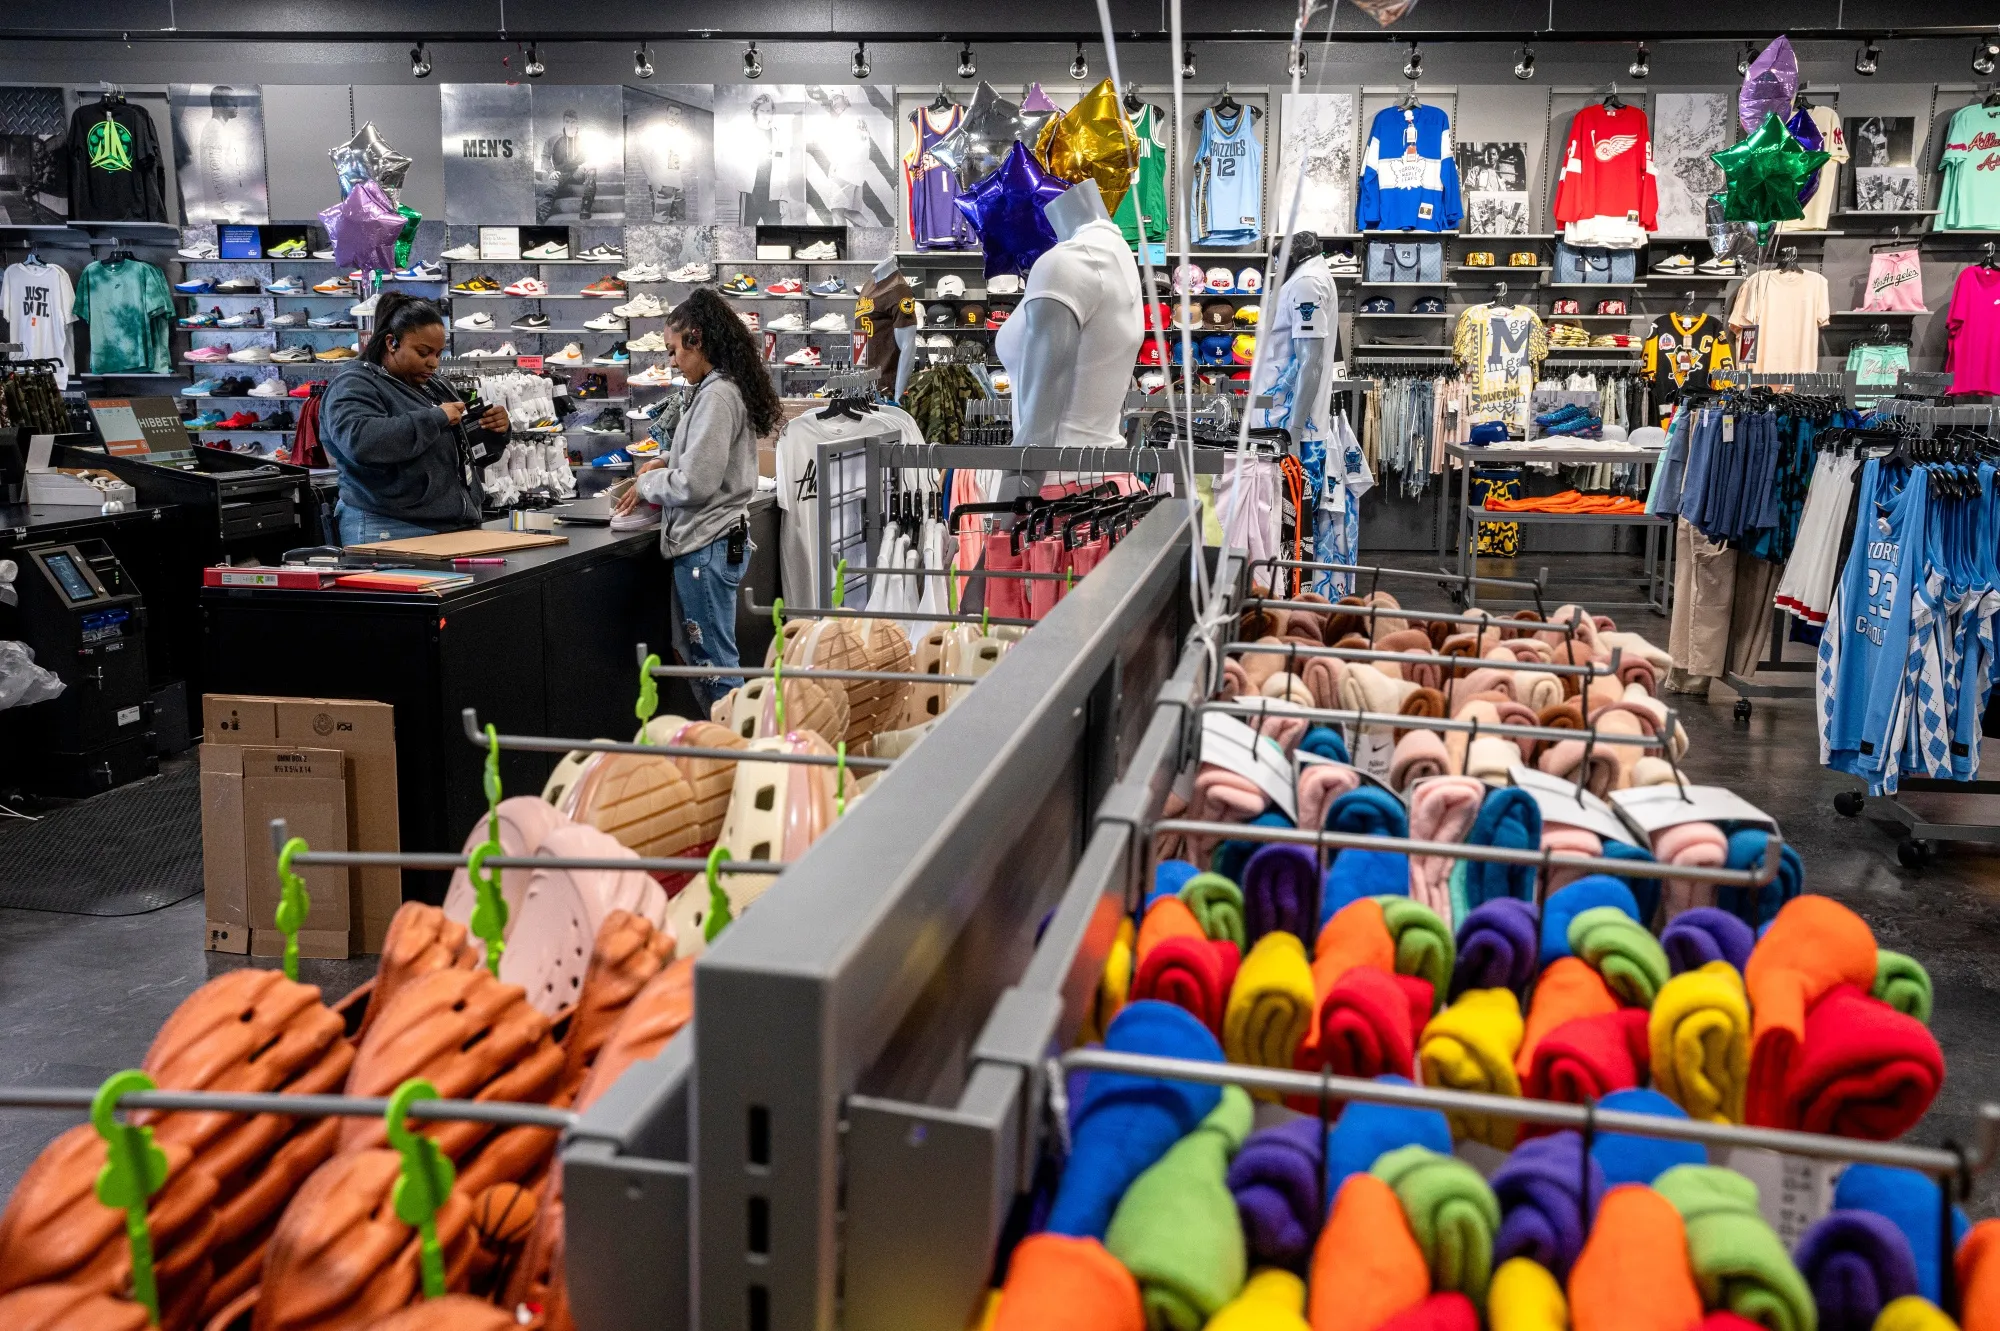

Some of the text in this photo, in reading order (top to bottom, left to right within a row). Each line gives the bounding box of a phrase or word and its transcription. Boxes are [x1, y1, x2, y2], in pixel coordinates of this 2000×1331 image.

[462, 139, 513, 158] MEN'S
[1216, 157, 1236, 177] 12
[1399, 165, 1421, 174] TORONTO
[24, 285, 50, 302] JUST
[36, 301, 50, 318] IT.
[137, 416, 180, 428] HIBBETT
